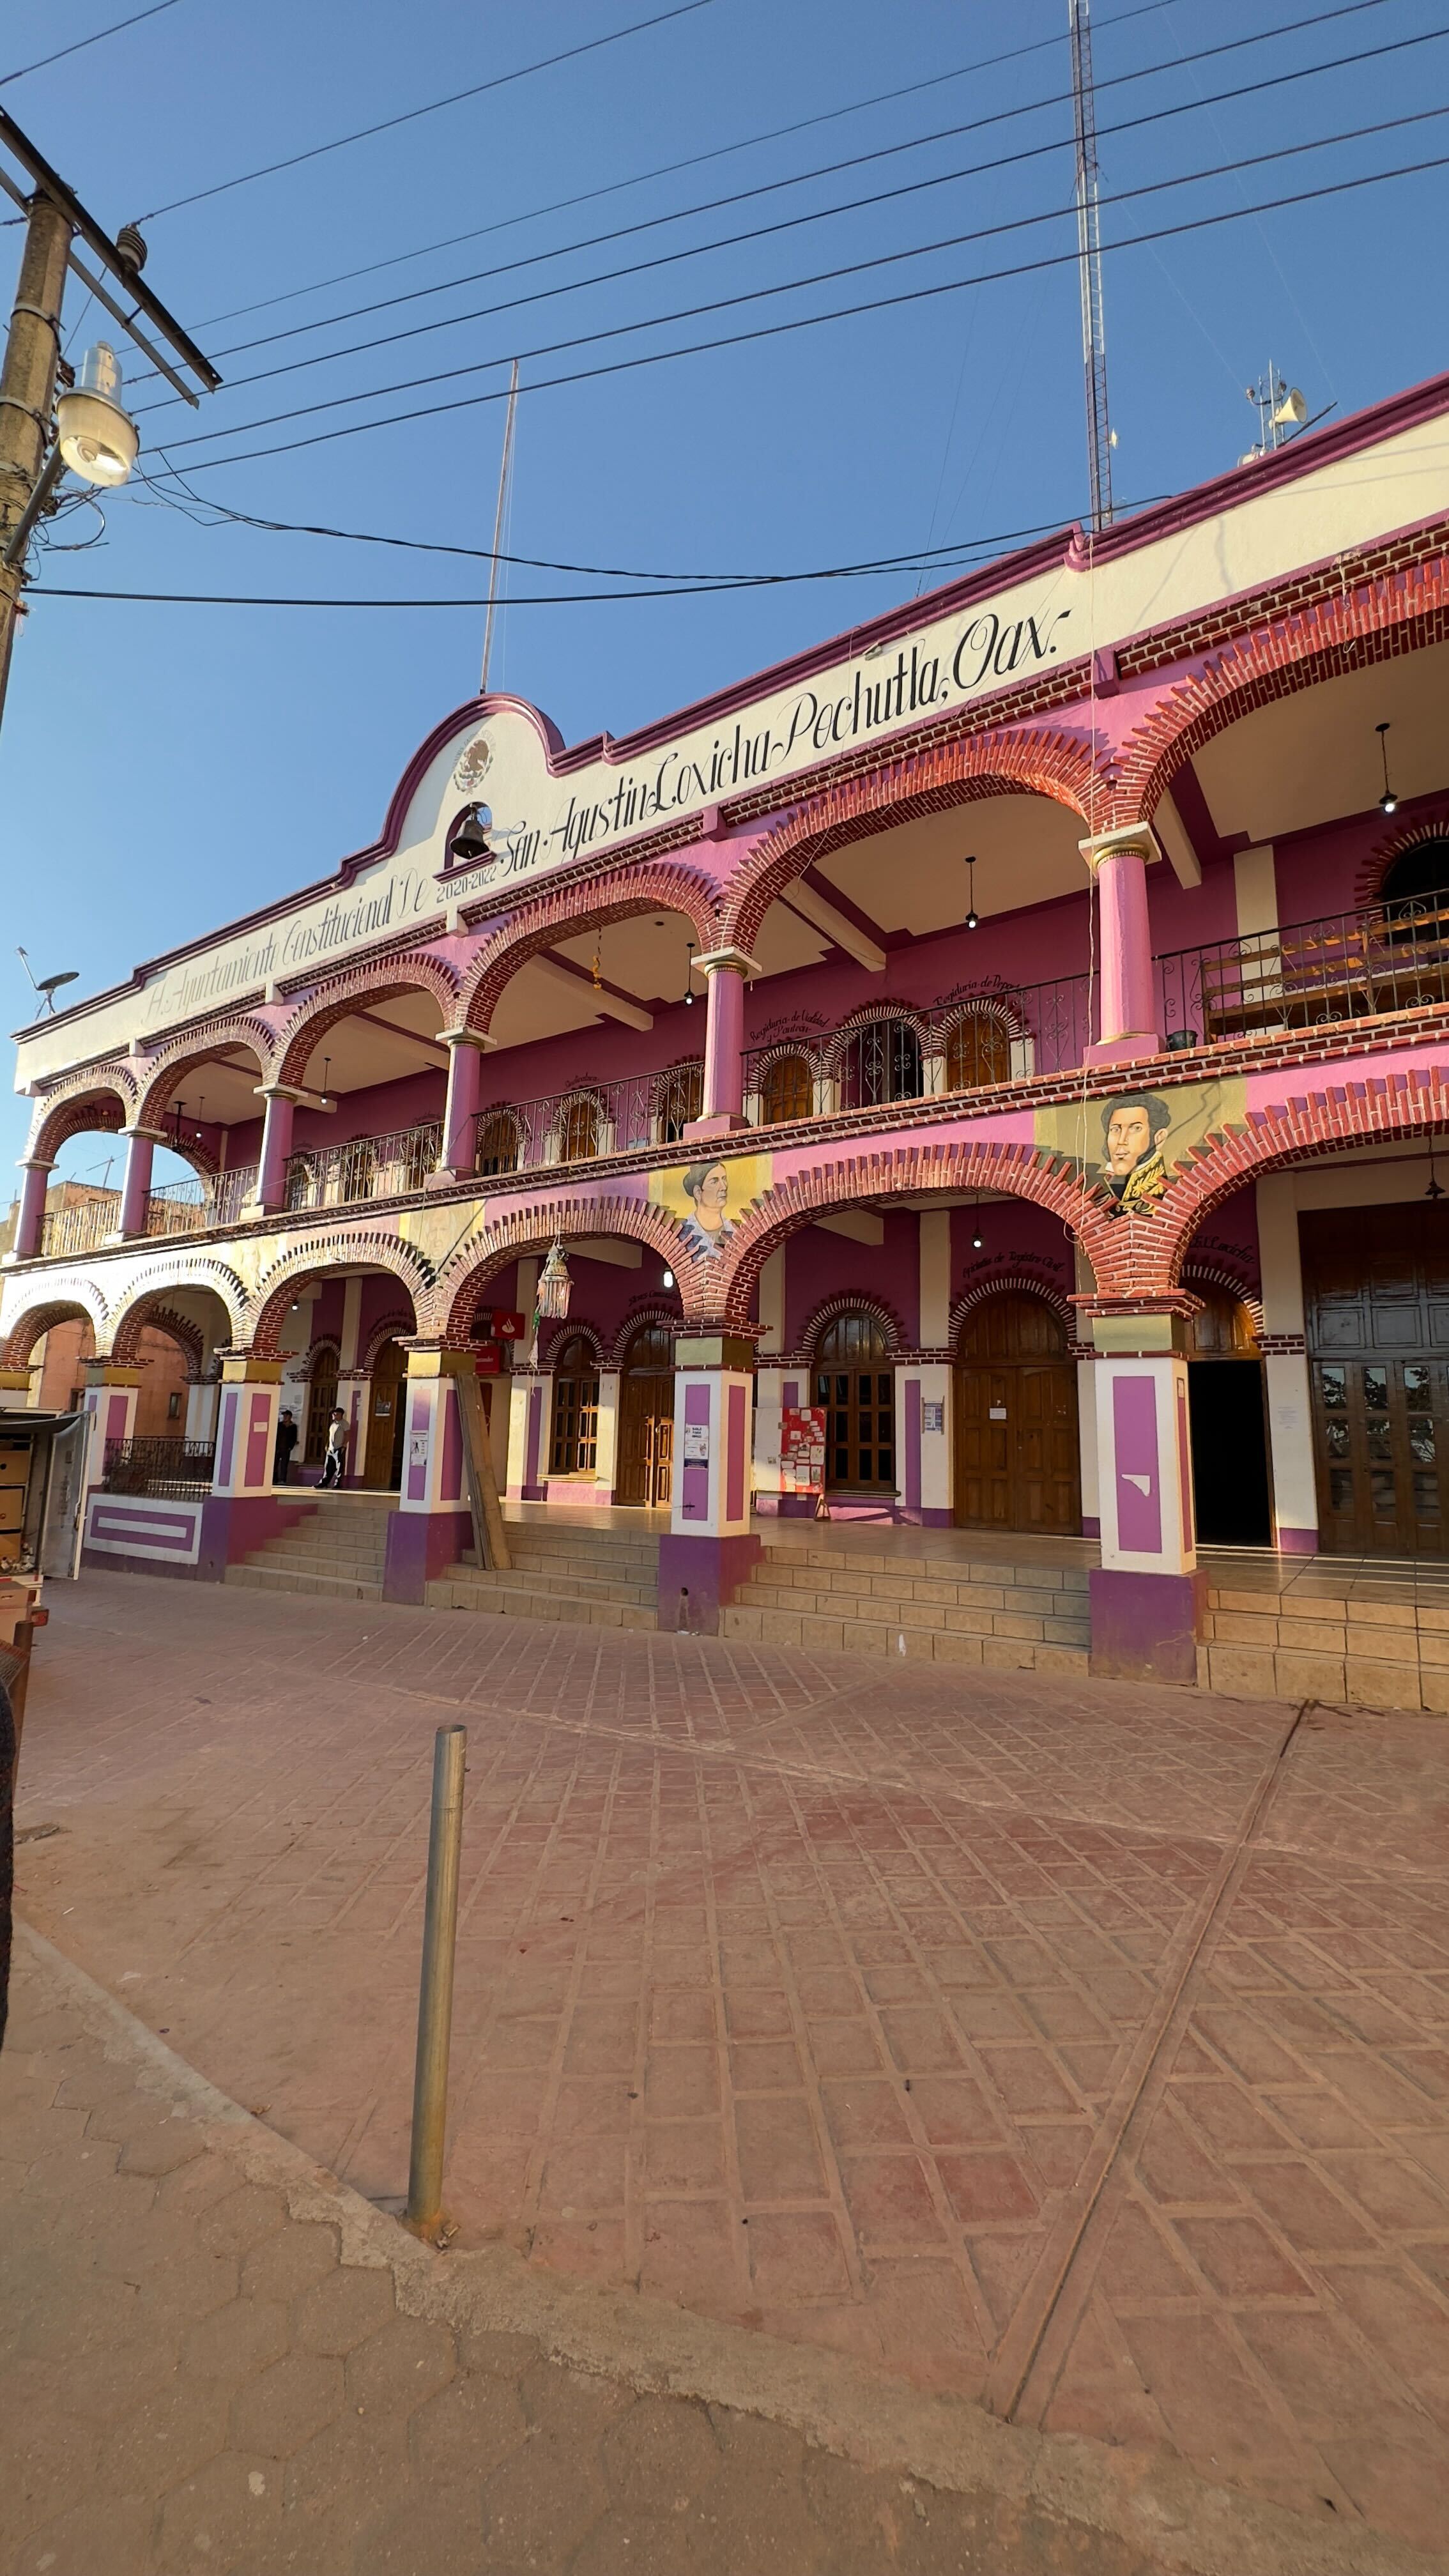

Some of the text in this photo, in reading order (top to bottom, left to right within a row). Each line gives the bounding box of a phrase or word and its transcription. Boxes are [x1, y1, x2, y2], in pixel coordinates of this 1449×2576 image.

[397, 868, 429, 919] De
[495, 820, 540, 877] San
[540, 776, 647, 864] Agustin
[646, 724, 770, 817] Loxicha
[953, 607, 1073, 689] Oax.
[436, 864, 496, 904] 2020-2022
